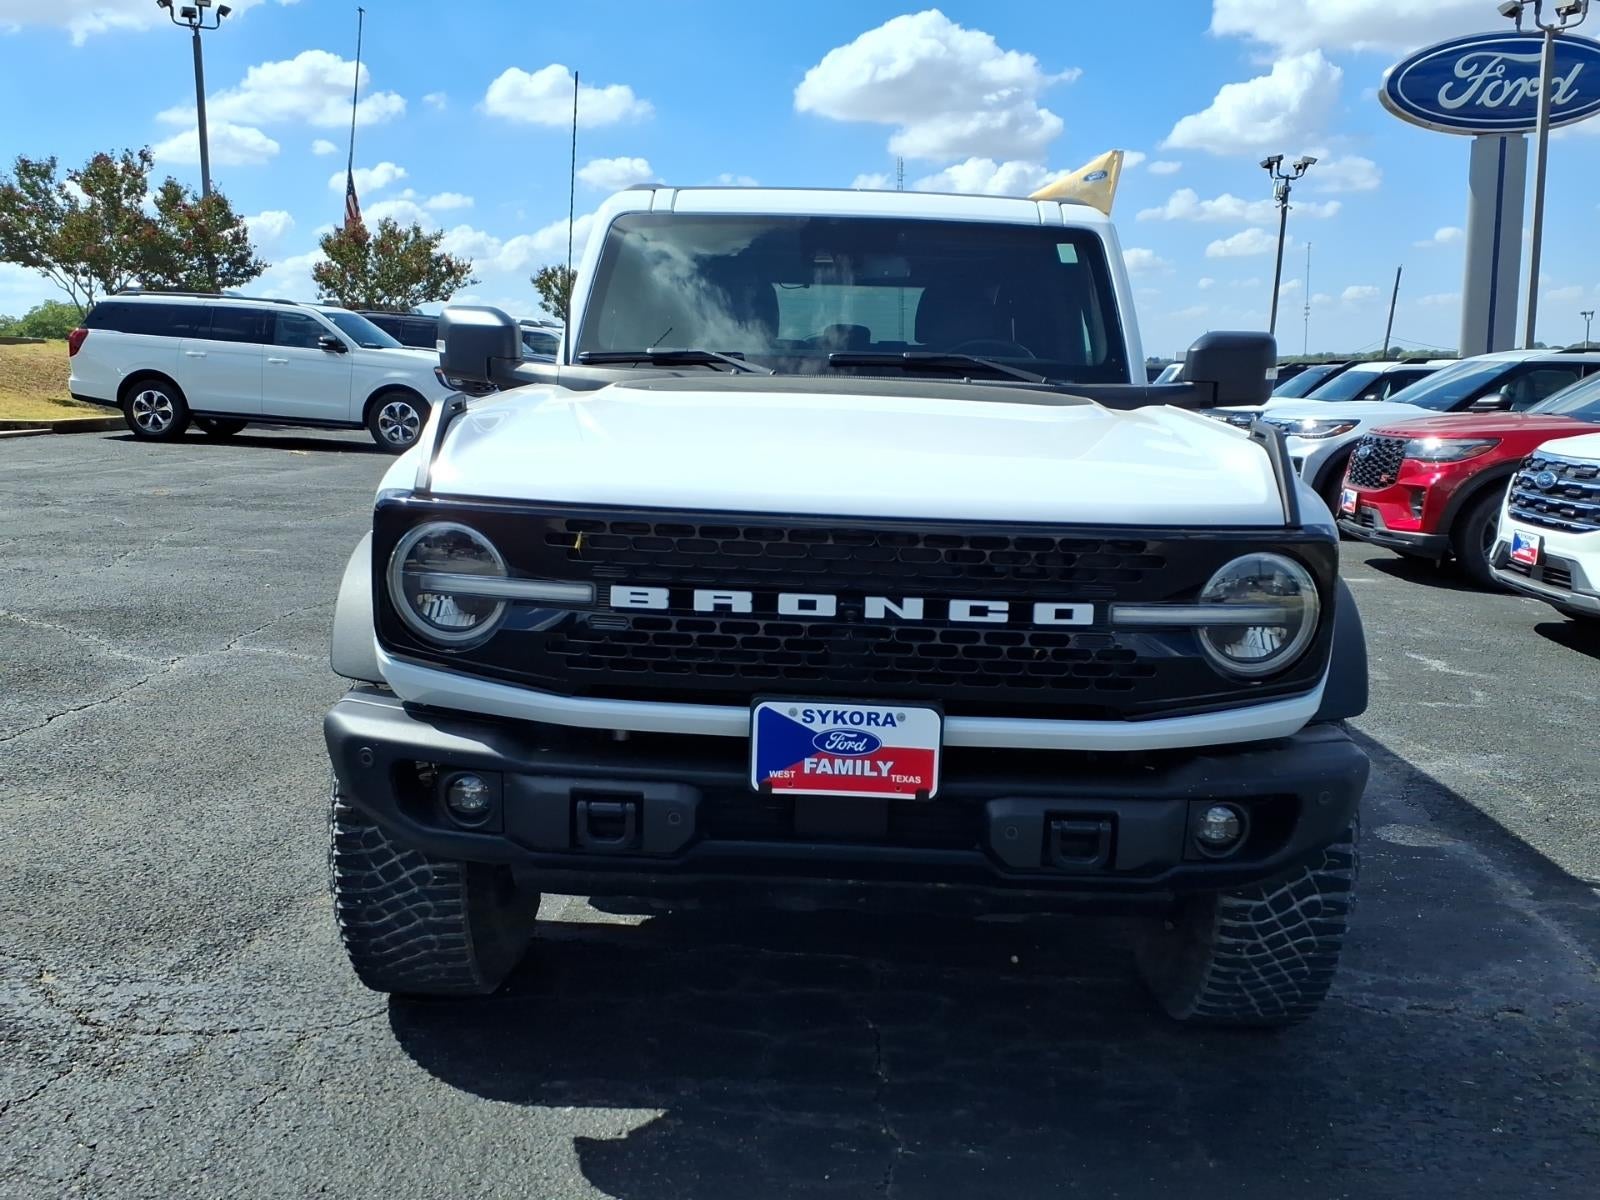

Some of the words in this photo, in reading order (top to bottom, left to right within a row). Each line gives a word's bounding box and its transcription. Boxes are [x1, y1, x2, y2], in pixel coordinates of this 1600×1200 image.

[1437, 51, 1585, 109] Ford
[610, 585, 1095, 625] BRONCO
[801, 708, 897, 727] SYKORA
[825, 731, 867, 752] Ford
[769, 770, 796, 779] WEST
[803, 757, 894, 777] FAMILY
[891, 774, 922, 784] TEXAS
